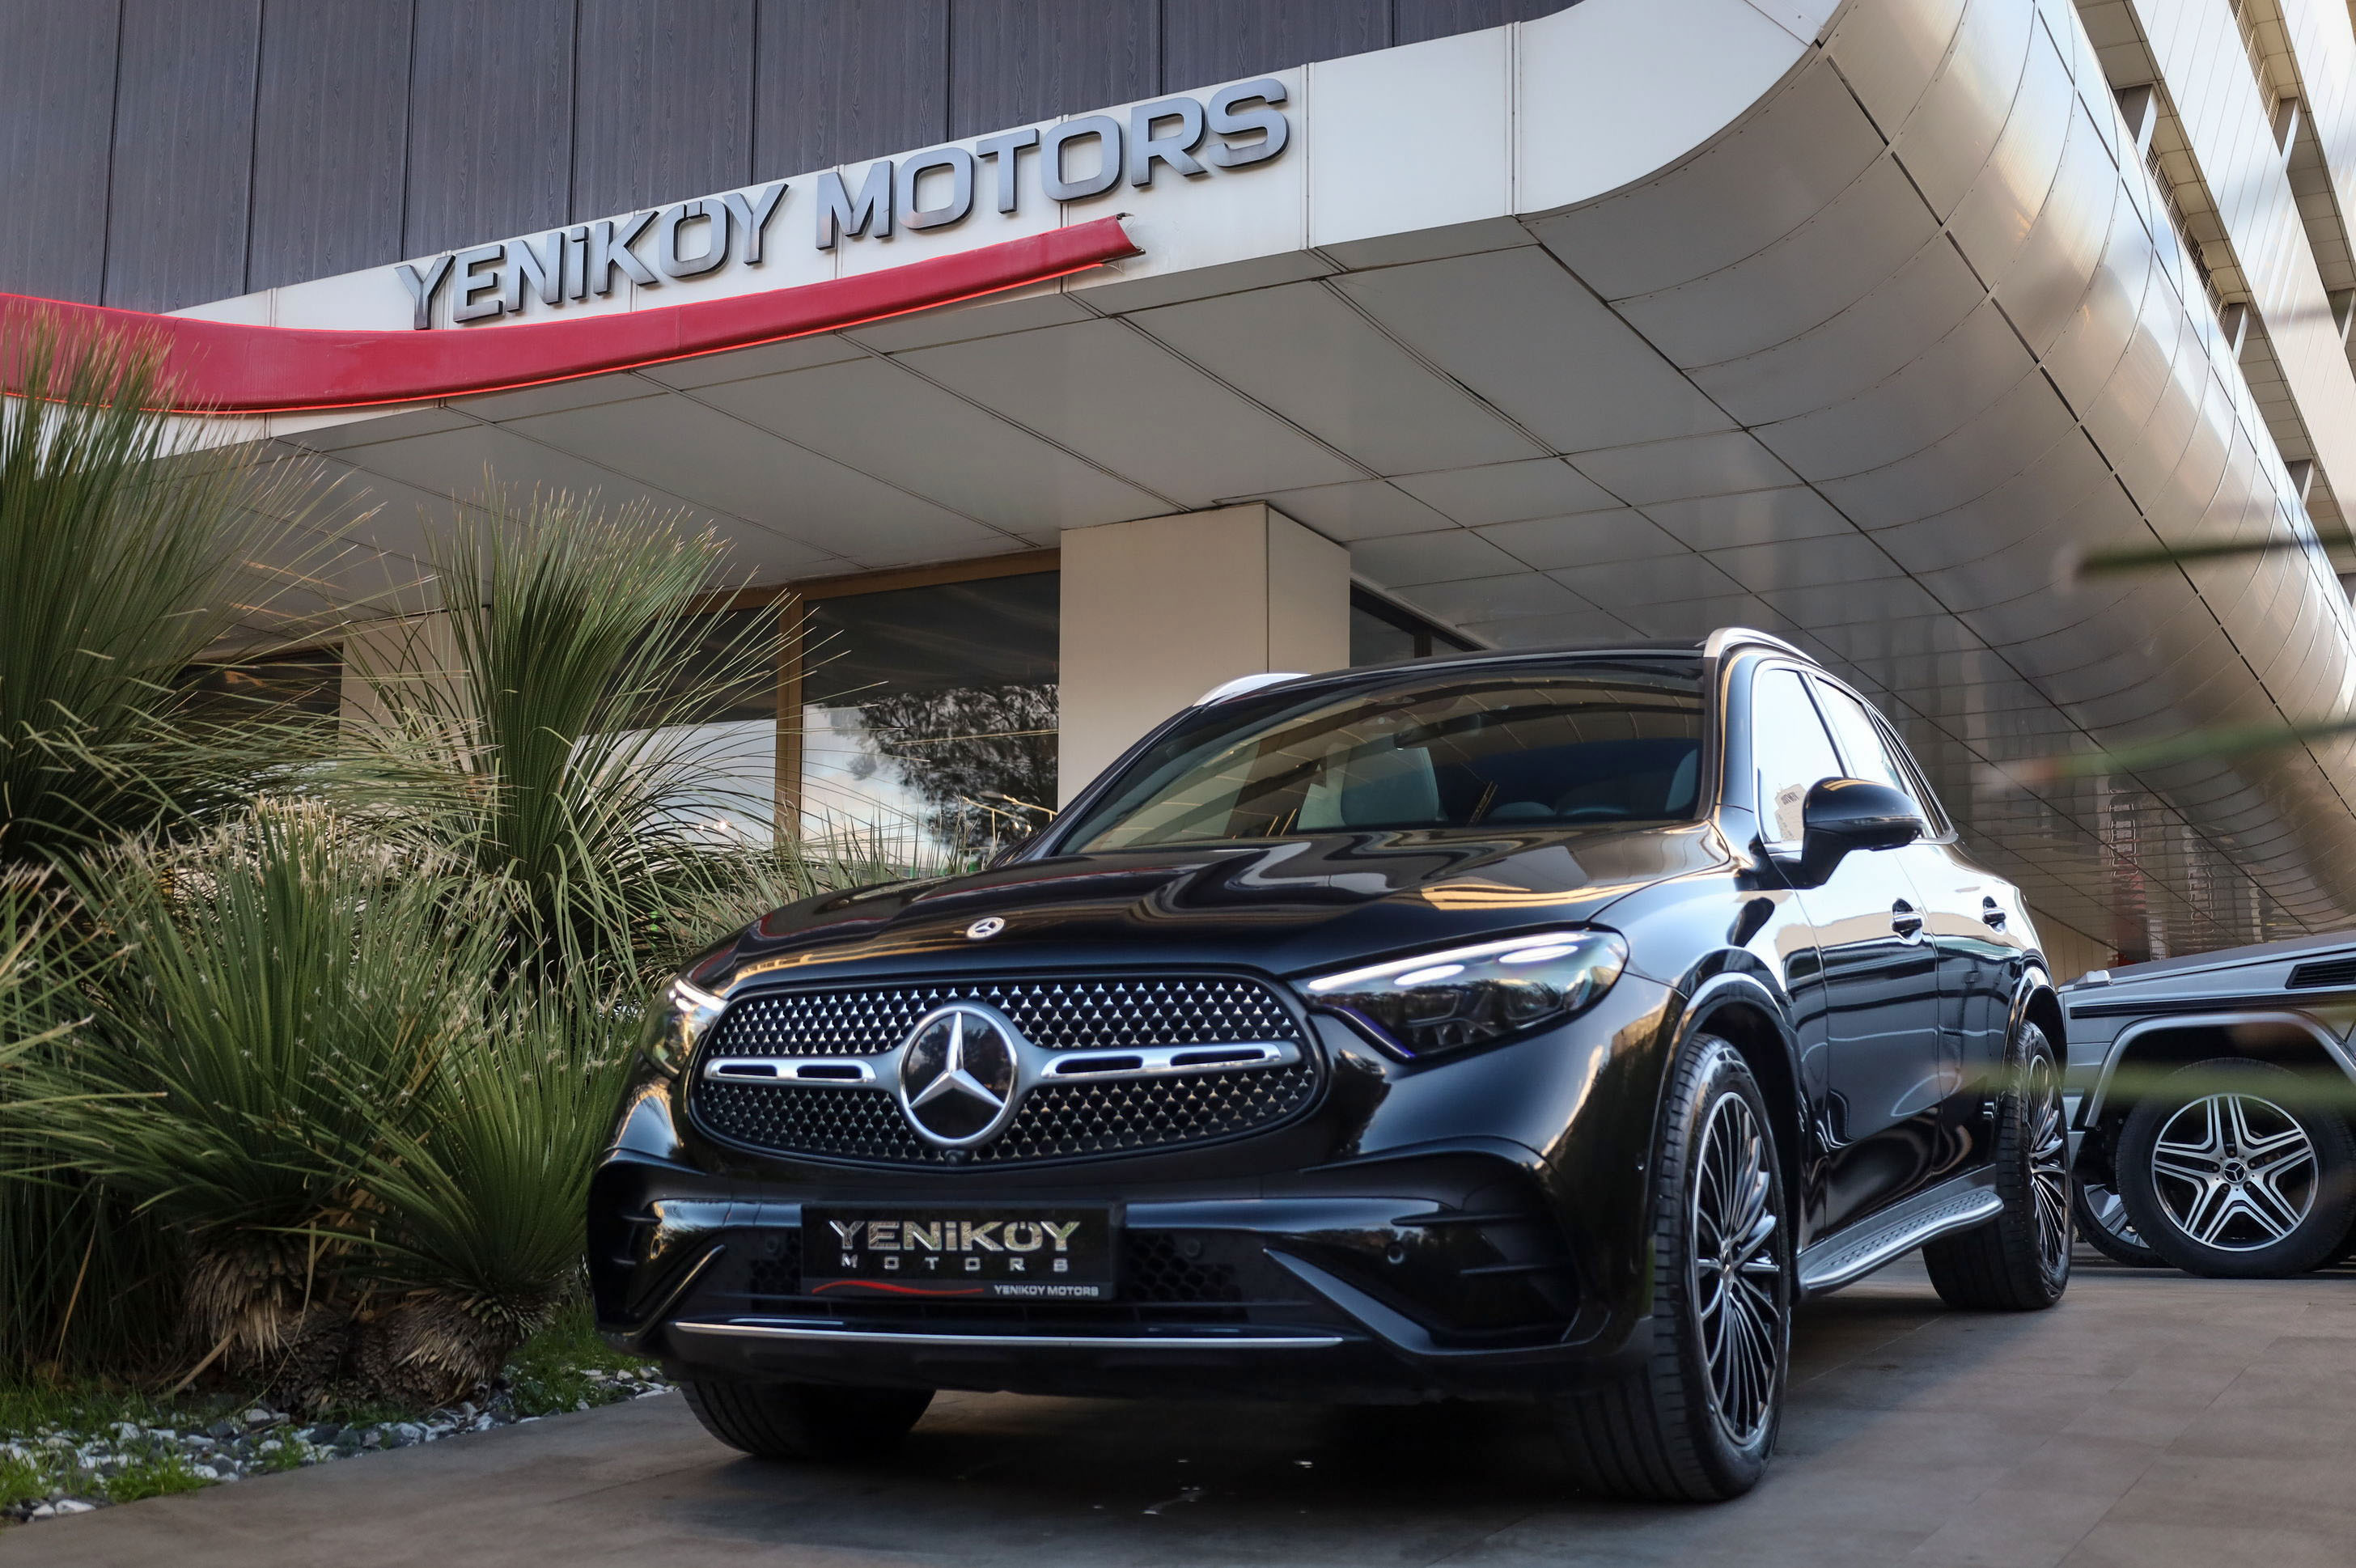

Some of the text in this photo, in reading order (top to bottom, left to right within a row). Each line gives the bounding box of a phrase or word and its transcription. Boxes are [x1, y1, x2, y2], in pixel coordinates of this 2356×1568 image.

[816, 78, 1290, 251] MOTORS
[841, 1252, 1069, 1272] MOTORS
[1048, 1286, 1099, 1296] MOTORS
